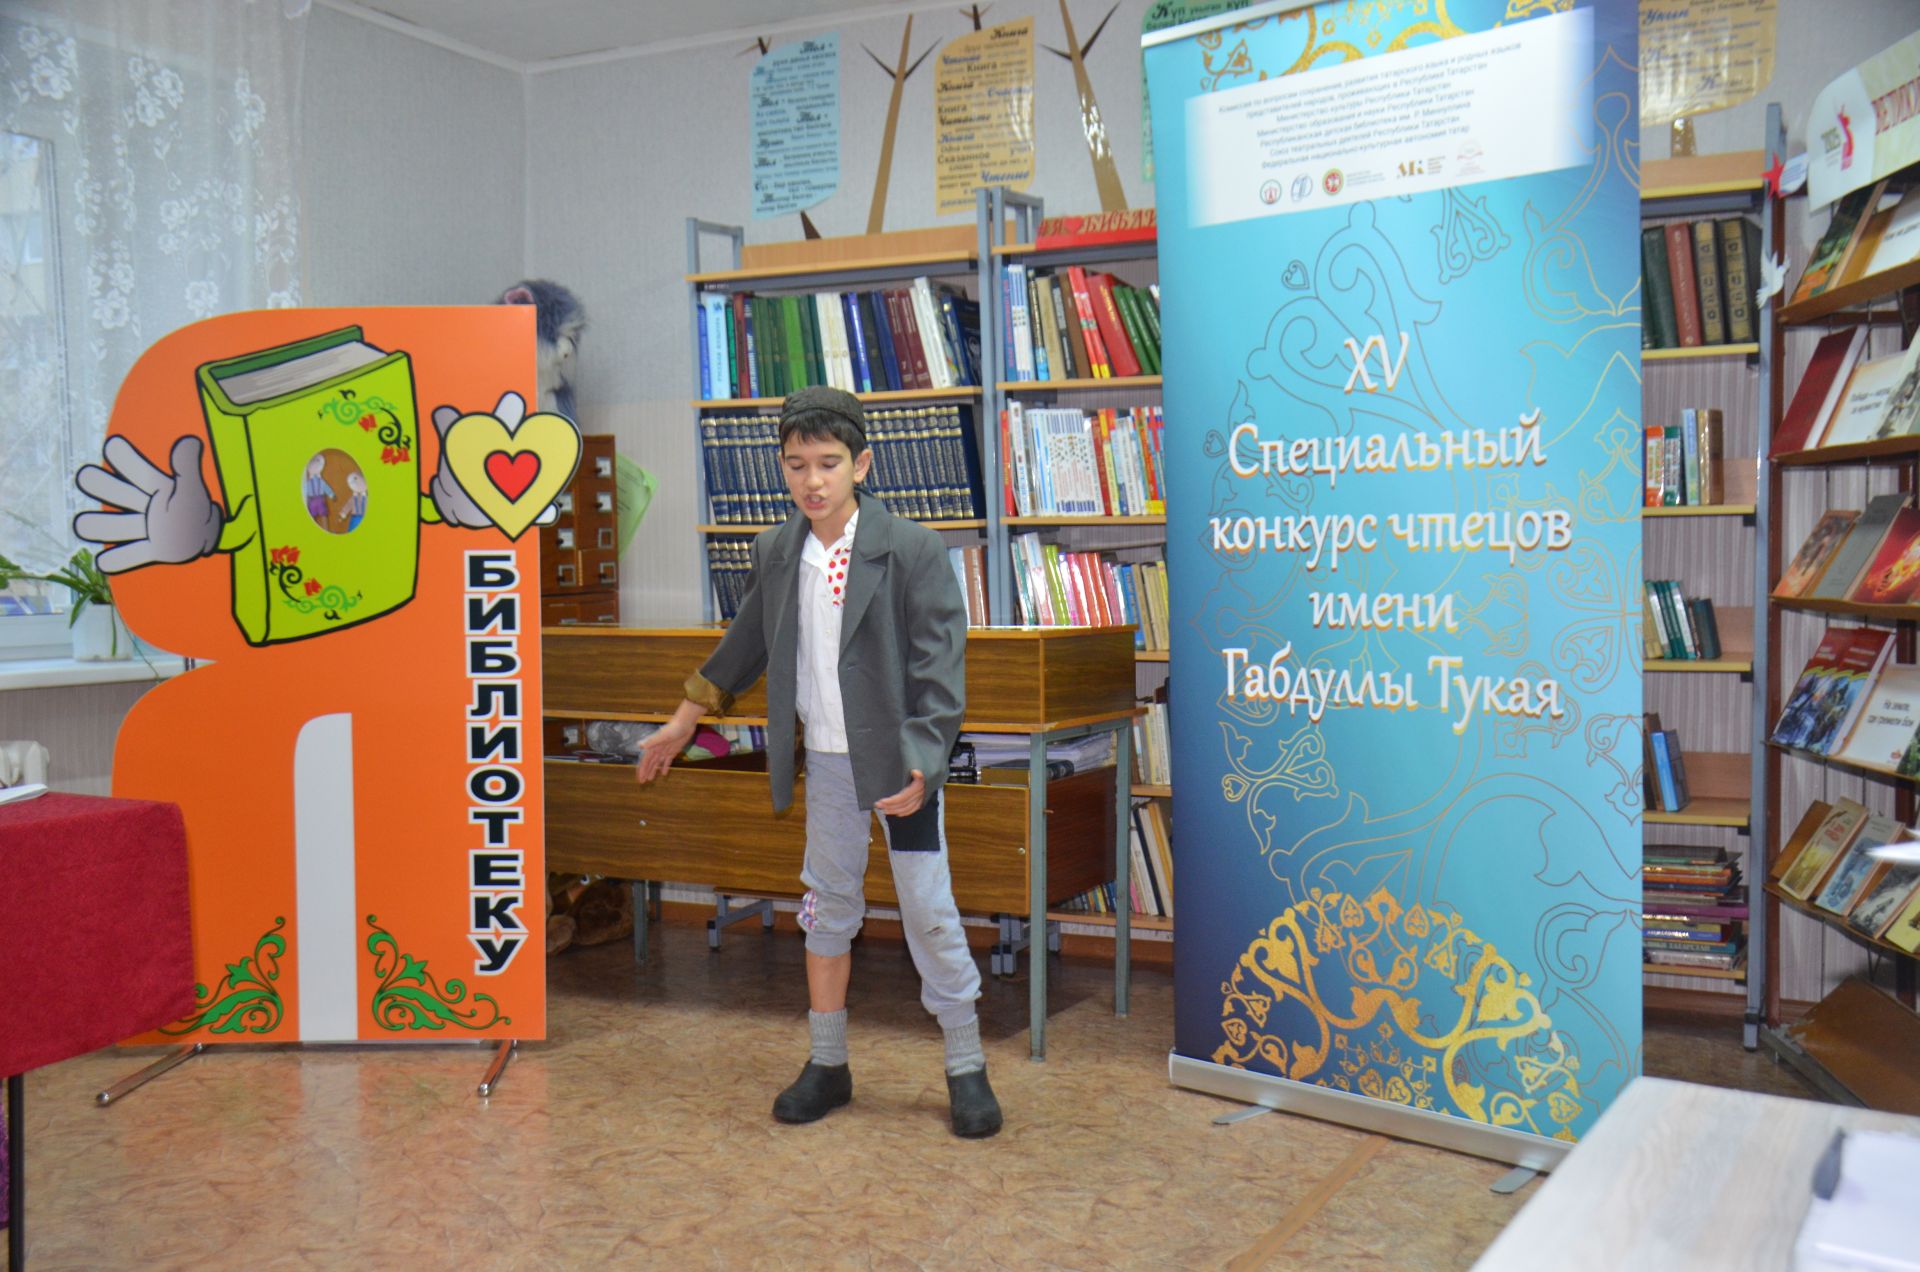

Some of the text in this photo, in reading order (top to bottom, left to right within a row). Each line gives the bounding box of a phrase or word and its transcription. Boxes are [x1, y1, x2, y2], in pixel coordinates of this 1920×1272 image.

[1446, 61, 1487, 77] Татарстан
[1256, 121, 1307, 138] Министерство
[1434, 87, 1474, 103] Татарстан
[1276, 106, 1328, 123] Министерство
[1412, 81, 1450, 96] Татарстан
[1421, 113, 1460, 128] Татарстан
[1343, 332, 1409, 395] XV
[1228, 407, 1548, 491] Специальный
[1209, 508, 1573, 571] конкурс чтецов
[1308, 590, 1460, 633] имени
[1221, 641, 1565, 734] Габдуллы Тукая
[464, 550, 529, 976] БИБЛИОТЕКУ
